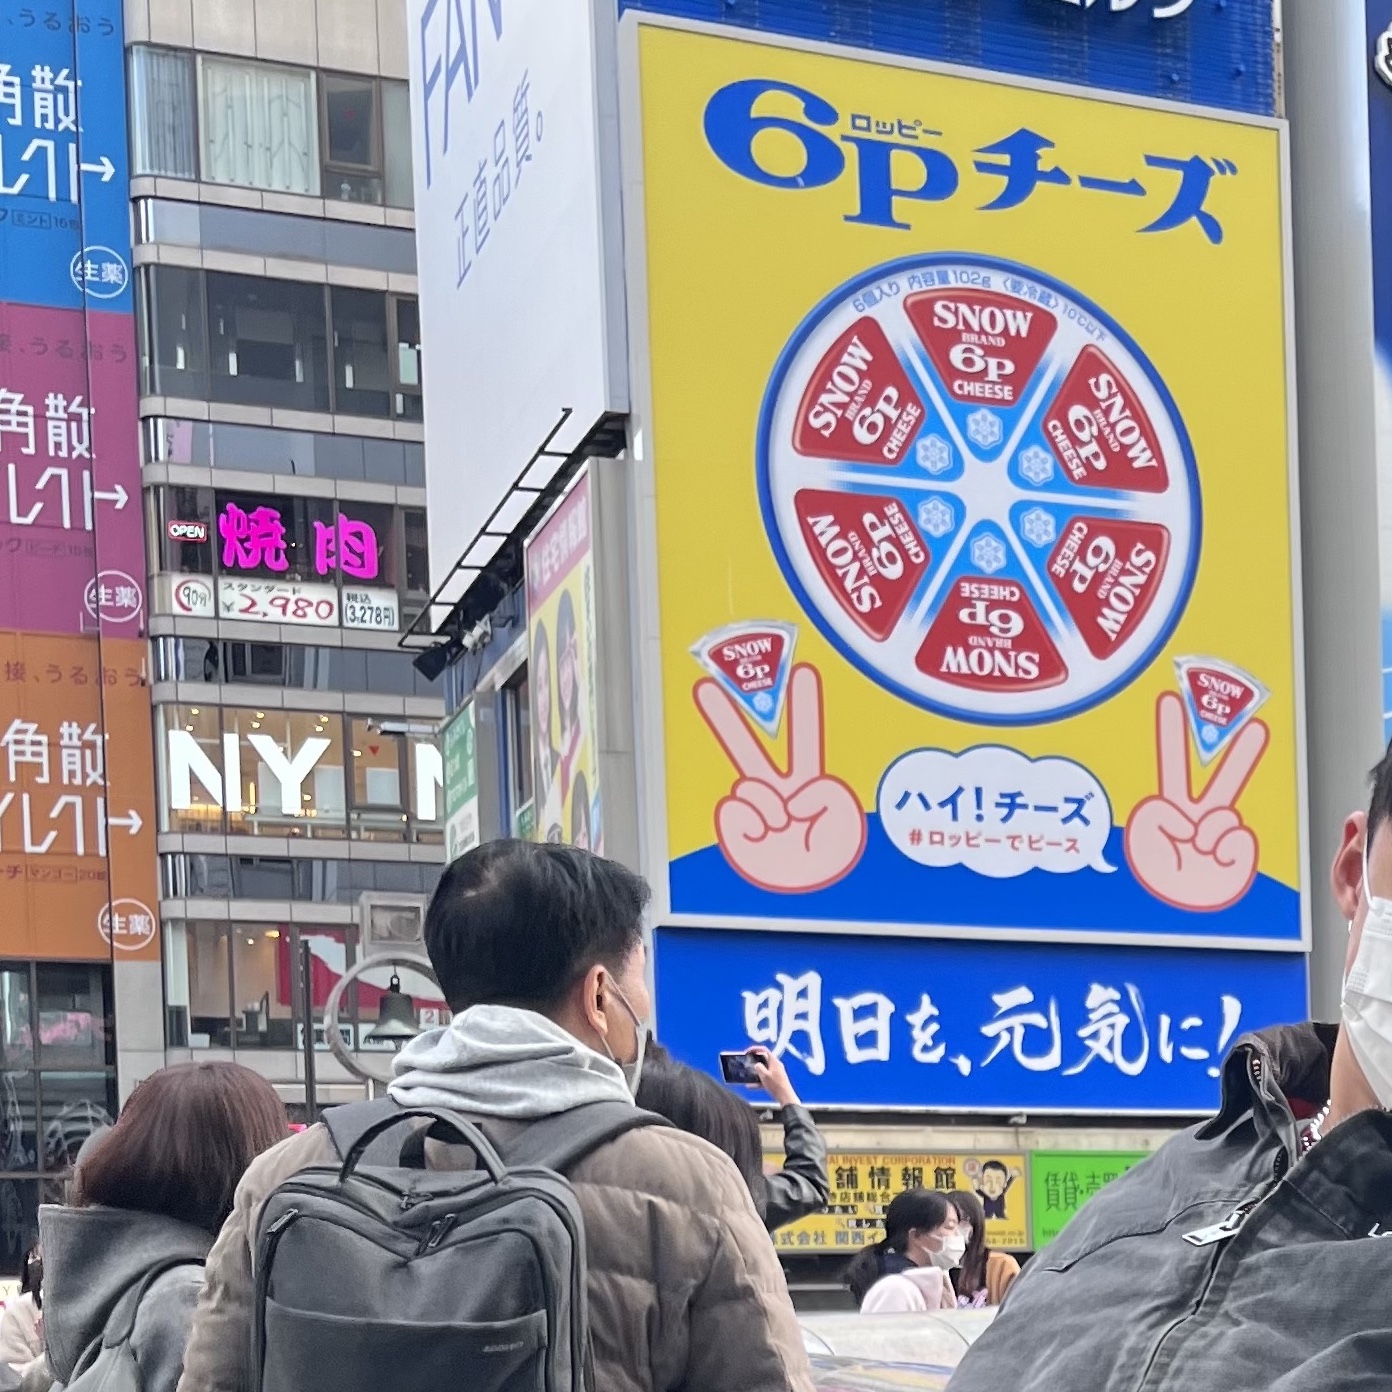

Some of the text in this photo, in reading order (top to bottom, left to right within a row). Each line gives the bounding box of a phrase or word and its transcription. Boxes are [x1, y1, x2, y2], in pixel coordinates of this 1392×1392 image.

[849, 112, 943, 140] ロッピー
[932, 300, 1035, 339] SNOW
[961, 332, 1006, 348] BRAND
[949, 344, 1016, 383] 6P
[807, 334, 875, 438] SNOW
[844, 378, 873, 422] BRAND
[952, 379, 1014, 401] CHEESE
[852, 385, 902, 445] 6P
[882, 402, 922, 460] CHEESE
[1087, 373, 1159, 469] SNOW
[1047, 419, 1088, 481] CHEESE
[1067, 404, 1108, 471] 6P
[169, 522, 206, 540] OPEN
[218, 501, 379, 580] 焼肉
[861, 511, 905, 580] 6P
[883, 501, 926, 565] CHEESE
[1050, 521, 1089, 579] CHEESE
[806, 514, 883, 614] SNOW
[1068, 535, 1117, 594] 6P
[959, 581, 1021, 602] CHEESE
[1096, 540, 1157, 642] SNOW
[958, 600, 1025, 638] 6P
[722, 636, 773, 662] SNOW
[939, 645, 1040, 680] SNOW
[967, 635, 1012, 649] BRAND
[1196, 673, 1245, 700] SNOW
[168, 730, 331, 815] NY
[102, 912, 151, 936] 生薬
[882, 1155, 957, 1166] CORPORATION
